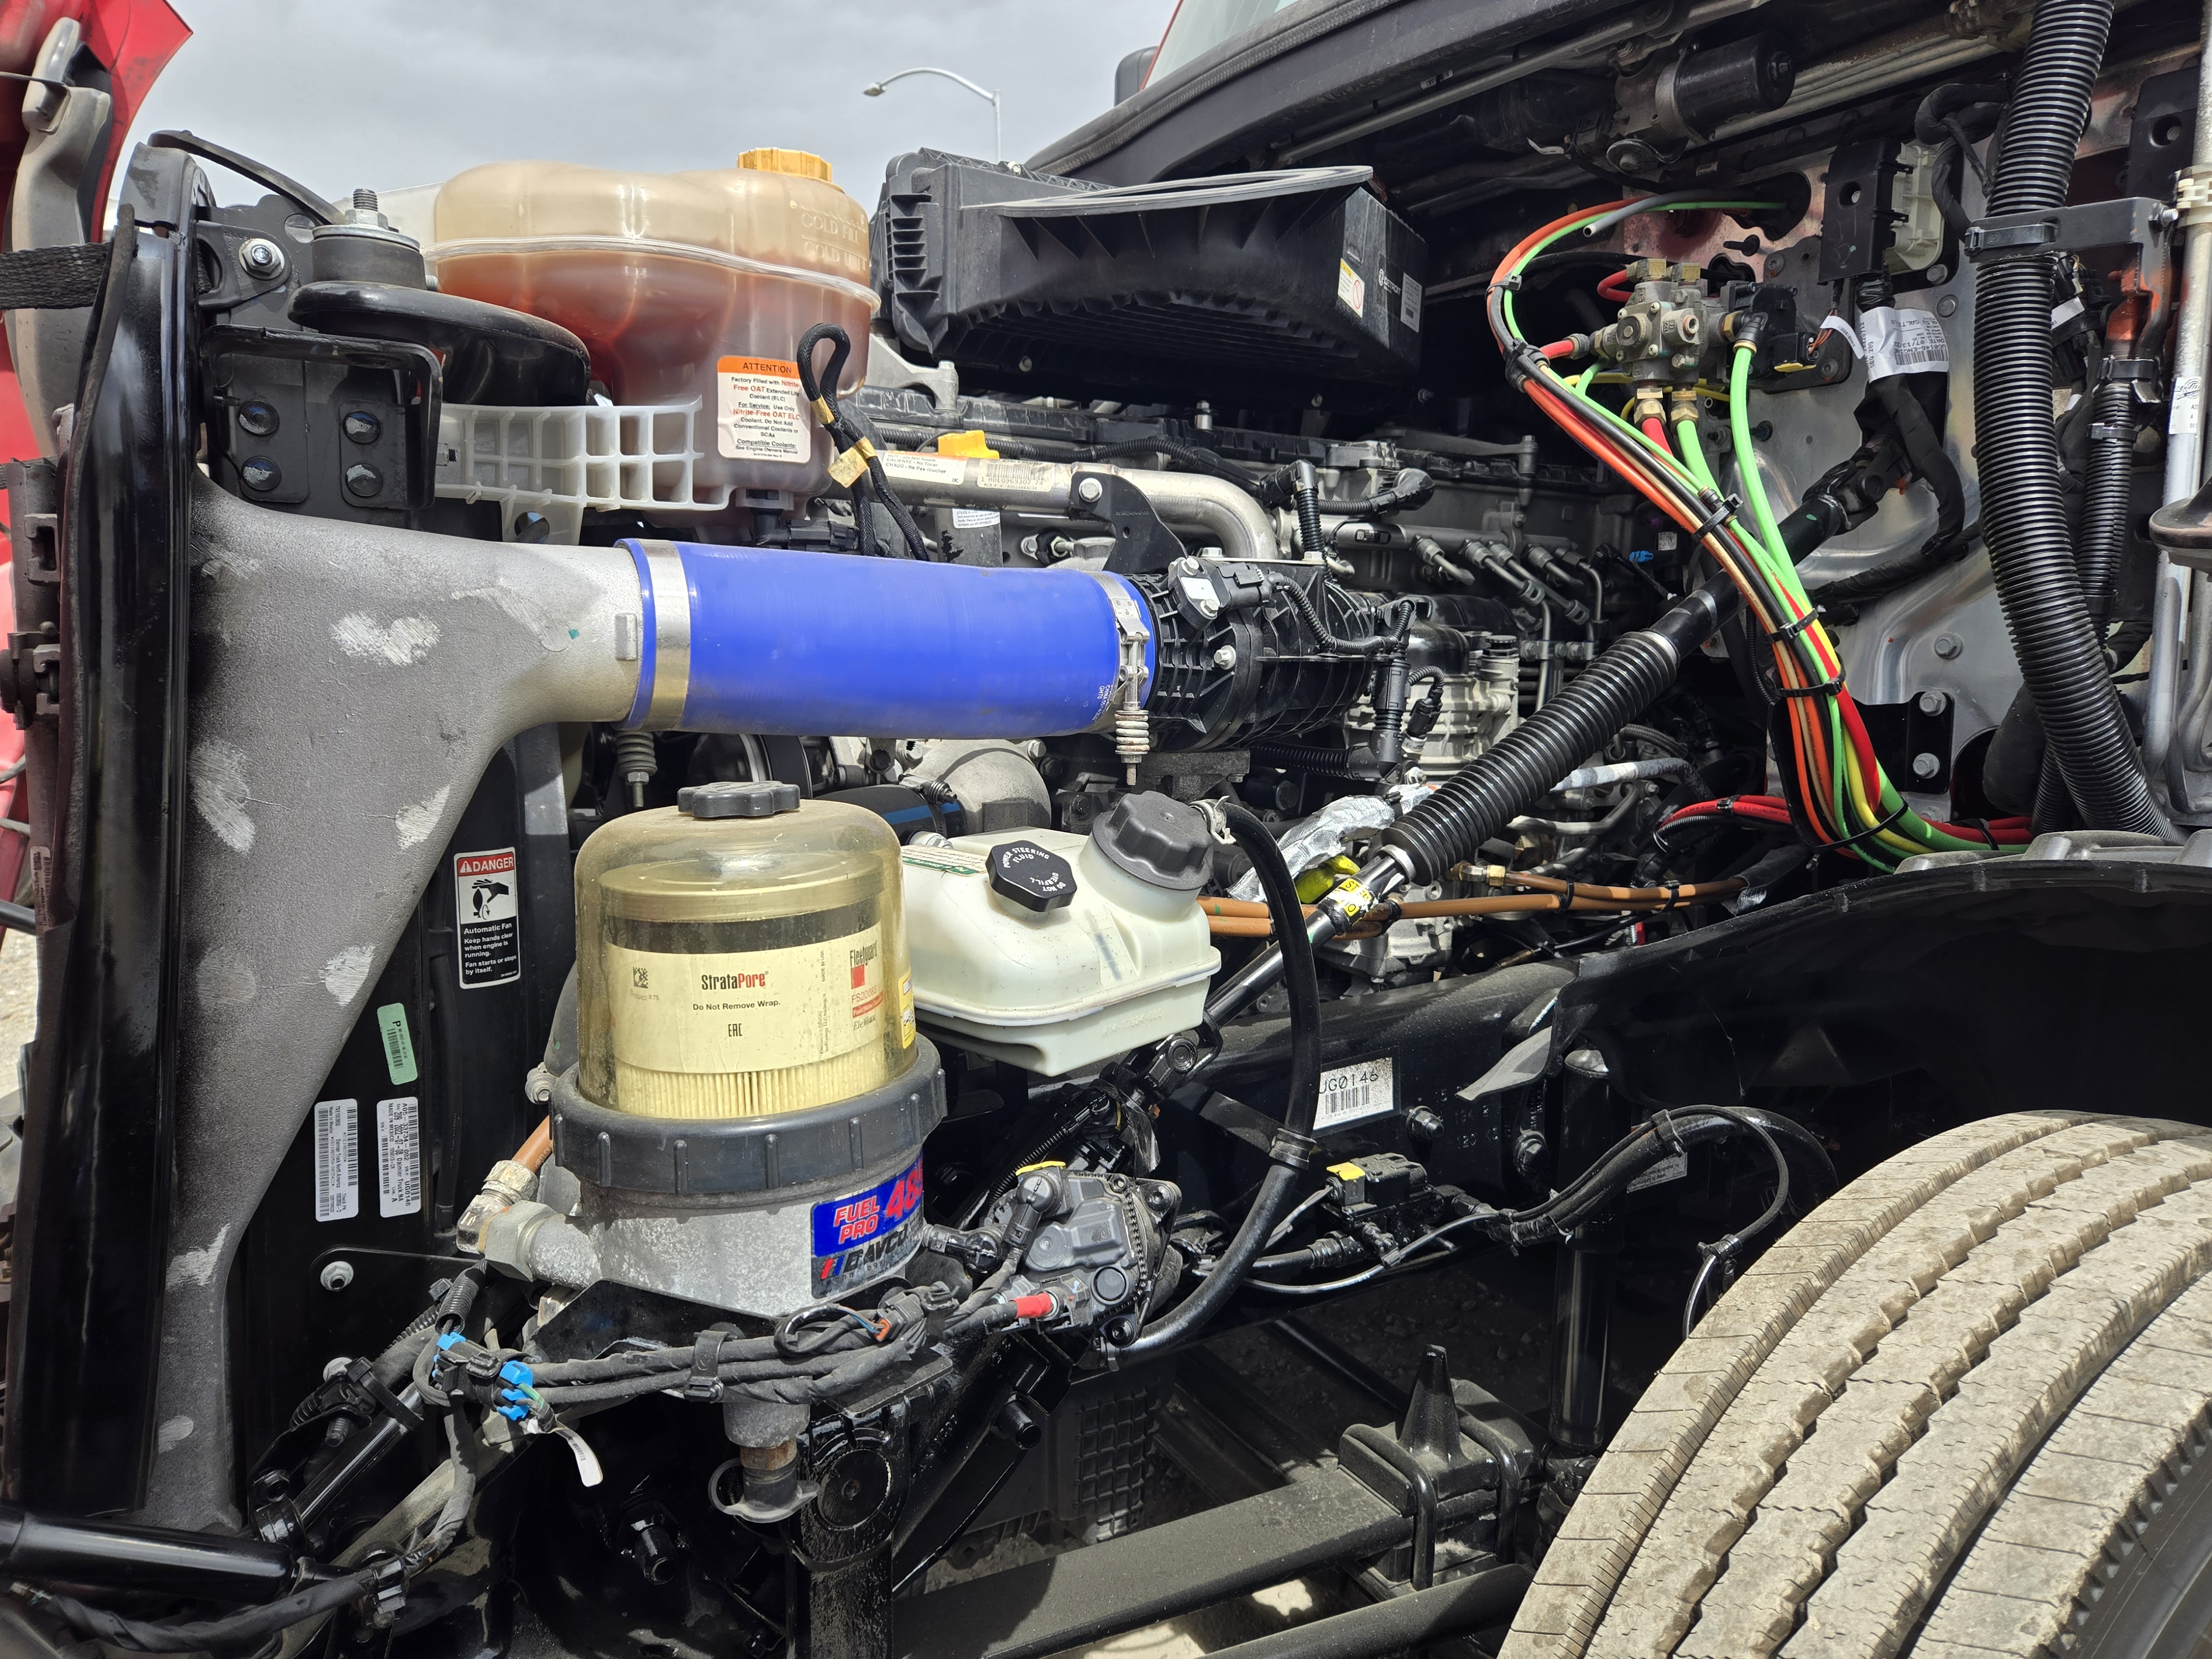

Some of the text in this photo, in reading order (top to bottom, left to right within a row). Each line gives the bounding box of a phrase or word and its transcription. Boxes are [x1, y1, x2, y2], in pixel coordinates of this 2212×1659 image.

[802, 213, 838, 234] COLD
[1384, 276, 1401, 295] DETROIT
[743, 363, 791, 373] ATTENTION
[781, 380, 801, 388] Nitrite-
[733, 409, 770, 417] Nitrite-Free
[1003, 851, 1013, 868] POWER
[1012, 847, 1050, 859] STEERING
[1013, 854, 1034, 863] FLUID
[473, 856, 514, 872] DANGER
[1030, 872, 1058, 885] OVERFILL
[464, 925, 500, 935] Automatic
[483, 942, 502, 951] engine
[504, 954, 517, 963] stops
[757, 1000, 781, 1009] Wrap.
[833, 1195, 880, 1227] FUEL
[838, 1214, 878, 1244] PRO
